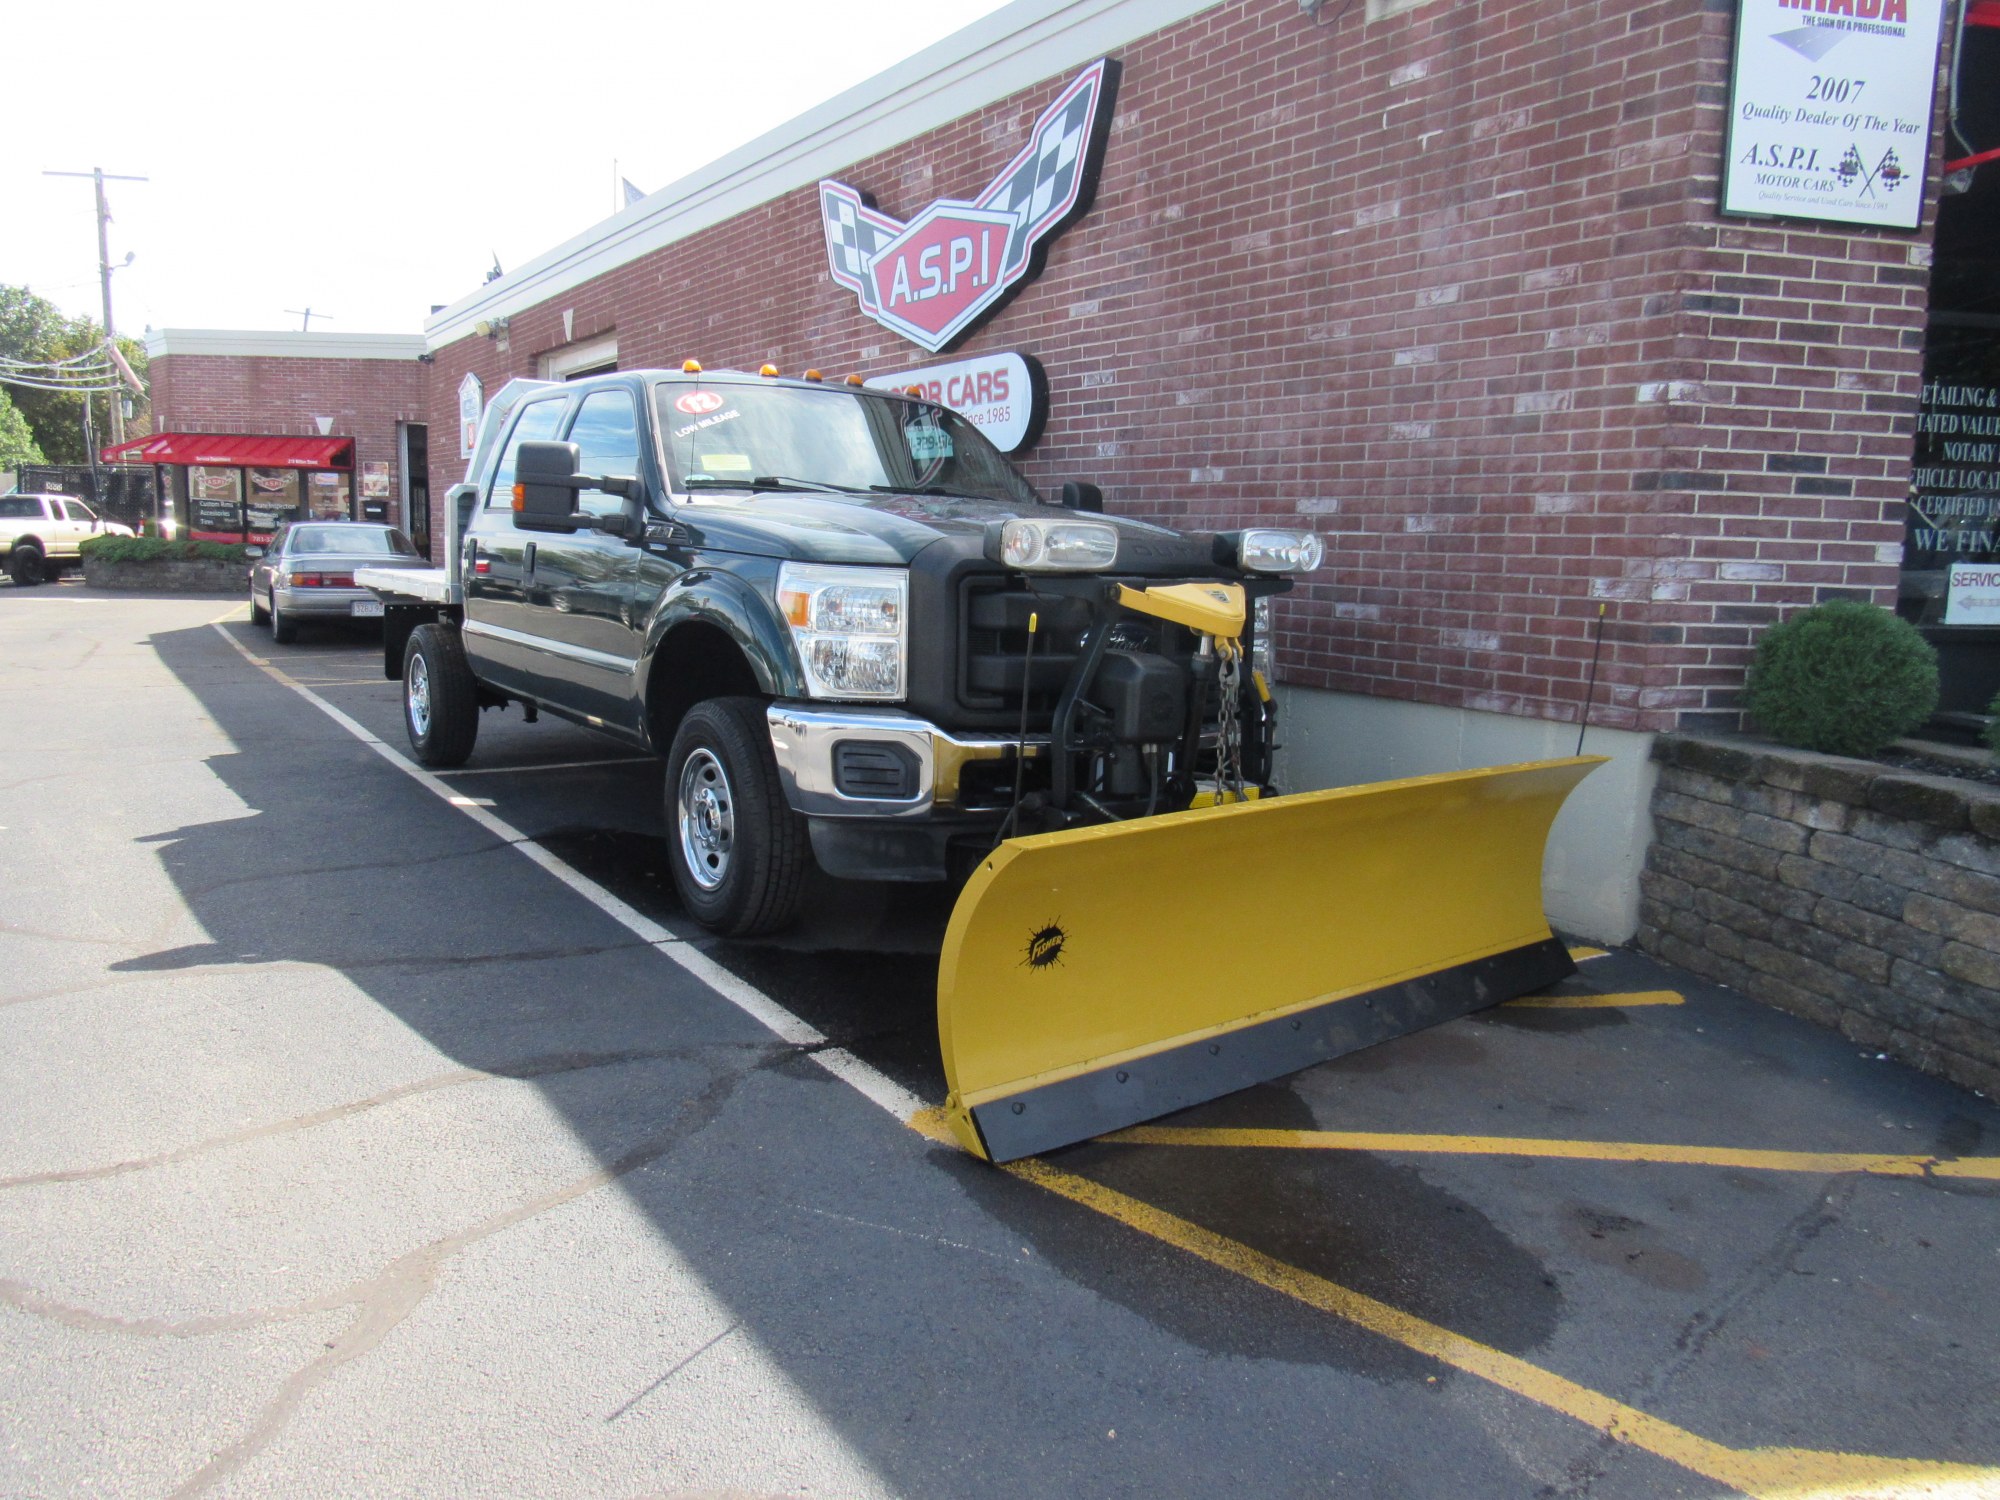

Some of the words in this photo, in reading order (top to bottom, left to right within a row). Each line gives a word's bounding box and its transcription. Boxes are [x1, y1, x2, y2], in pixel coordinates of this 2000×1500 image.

[1802, 15, 1816, 26] THE
[1817, 16, 1835, 29] SIGN
[1836, 18, 1847, 30] OF
[1847, 20, 1852, 31] A
[1853, 22, 1906, 38] PROFESSIONAL
[1805, 75, 1866, 104] 2007
[1742, 101, 1792, 124] Quality
[1794, 108, 1839, 126] Dealer
[1842, 112, 1861, 132] Of
[1863, 115, 1888, 132] The
[1892, 117, 1921, 135] Year
[1741, 142, 1820, 172] A.S.P.I.
[1754, 173, 1800, 189] MOTOR
[1803, 178, 1836, 193] CARS
[1758, 191, 1782, 201] Quality
[889, 229, 989, 307] A.S.P.I
[947, 368, 1009, 407] CARS
[1919, 384, 1985, 407] ETAILING
[1986, 388, 1997, 407] &
[675, 424, 699, 438] LOW
[698, 409, 741, 428] MILEAGE
[986, 406, 1012, 424] 1985
[1916, 413, 1959, 433] TATED
[1943, 441, 1996, 462] NOTARY
[268, 503, 297, 511] Inspection
[1917, 495, 1985, 516] CERTIFIED
[1914, 528, 1949, 552] WE
